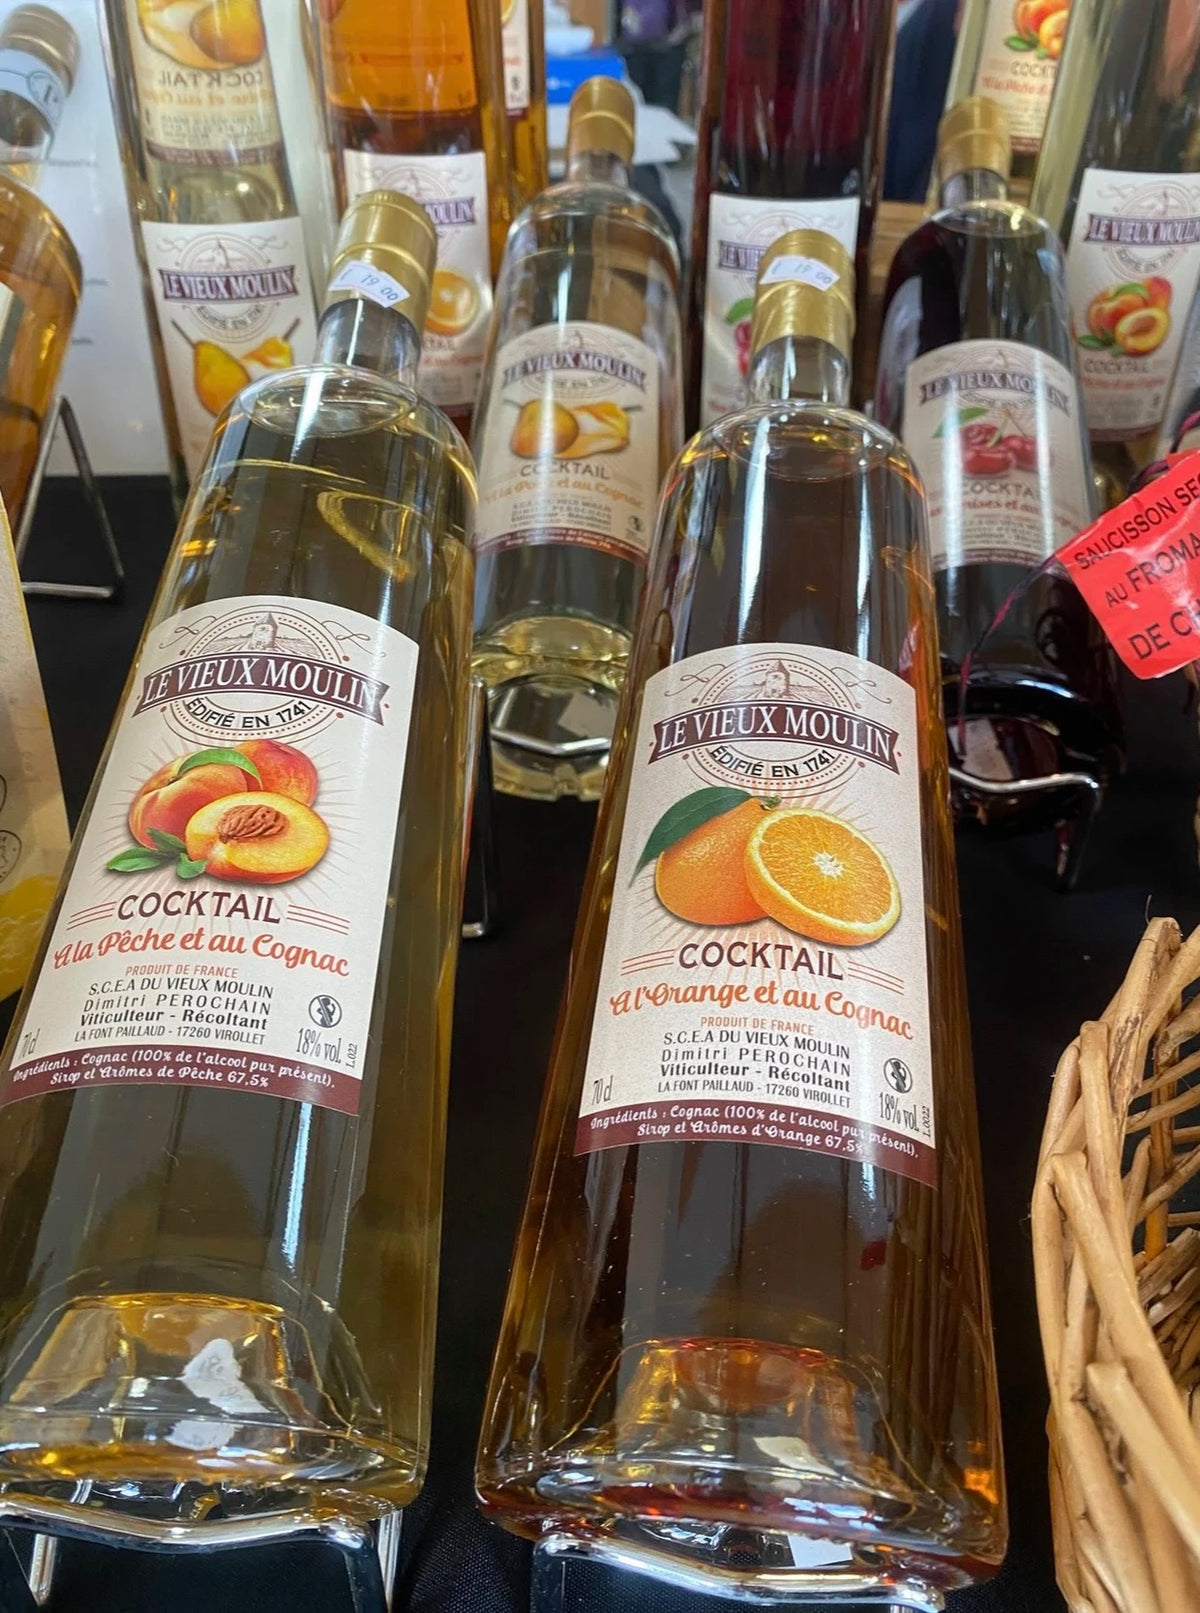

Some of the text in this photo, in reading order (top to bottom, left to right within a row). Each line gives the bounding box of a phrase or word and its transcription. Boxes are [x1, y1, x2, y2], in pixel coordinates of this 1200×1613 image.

[1088, 220, 1110, 241] LE
[165, 270, 294, 299] LE VIEUX MOULIN
[360, 271, 399, 301] 19 00
[525, 351, 577, 374] VIEUX
[578, 351, 645, 386] MOULIN
[953, 371, 1002, 390] IEUX
[520, 460, 610, 480] COCKTAIL
[961, 480, 1036, 498] COCKTA
[1074, 497, 1177, 571] SAUCISSON
[1173, 473, 1200, 508] SE
[1104, 583, 1129, 608] AU
[1128, 623, 1171, 661] DE
[143, 657, 378, 710] LE VIEUX MOULIN
[241, 714, 270, 729] EN
[276, 700, 313, 724] 1741
[659, 705, 892, 762] LE VIEUX MOULIN
[710, 745, 836, 778] ÉDIFIÉ EN 1741
[117, 890, 281, 924] COCKTAIL
[54, 927, 350, 978] A la Pêche et au Cognac
[678, 941, 844, 981] COCKTAIL
[125, 964, 239, 979] PRODUIT DE FRANCE
[88, 977, 274, 999] S.C.E.A DU VIEUX MOULIN
[79, 1009, 165, 1027] Viticulteur
[181, 1008, 269, 1031] Récoltant
[83, 993, 272, 1016] Dimitri PEROCHAIN
[610, 980, 914, 1040] A l'Orange et au Cognac
[74, 1028, 87, 1042] LA
[88, 1026, 114, 1040] FONT
[115, 1025, 166, 1038] PAILLAUD
[176, 1026, 212, 1040] 17260
[214, 1028, 266, 1046] VIROLLET
[700, 1016, 815, 1037] PRODUIT DE FRANCE
[296, 1027, 321, 1058] 18%
[663, 1029, 851, 1060] S.C.E.A DU VIEUX MOULIN
[13, 1056, 71, 1082] Ingrédients
[81, 1051, 128, 1066] Cognac
[131, 1049, 172, 1064] (100%
[175, 1049, 193, 1063] de
[195, 1051, 247, 1069] l'alcool
[249, 1060, 276, 1073] pur
[50, 1068, 81, 1085] Sirop
[83, 1067, 96, 1081] et
[99, 1066, 153, 1079] Arômes
[157, 1065, 175, 1078] de
[178, 1065, 223, 1082] Pêche
[659, 1061, 750, 1078] Viticulteur
[767, 1065, 851, 1093] Récoltant
[661, 1047, 851, 1078] Dimitri PEROCHAIN
[657, 1081, 673, 1093] LA
[673, 1079, 701, 1092] FONT
[702, 1079, 754, 1093] PAILLAUD
[765, 1083, 800, 1098] 17260
[802, 1087, 851, 1109] VIROLLET
[879, 1091, 901, 1125] 18%
[590, 1106, 658, 1130] Ingrédients
[670, 1104, 720, 1119] Cognac
[724, 1105, 766, 1120] (100%
[769, 1109, 787, 1123] de
[789, 1110, 840, 1132] l'alcool
[842, 1124, 865, 1139] pur
[637, 1122, 671, 1138] Sirop
[674, 1120, 687, 1134] et
[690, 1120, 747, 1136] Arômes
[751, 1123, 822, 1147] d'Orange
